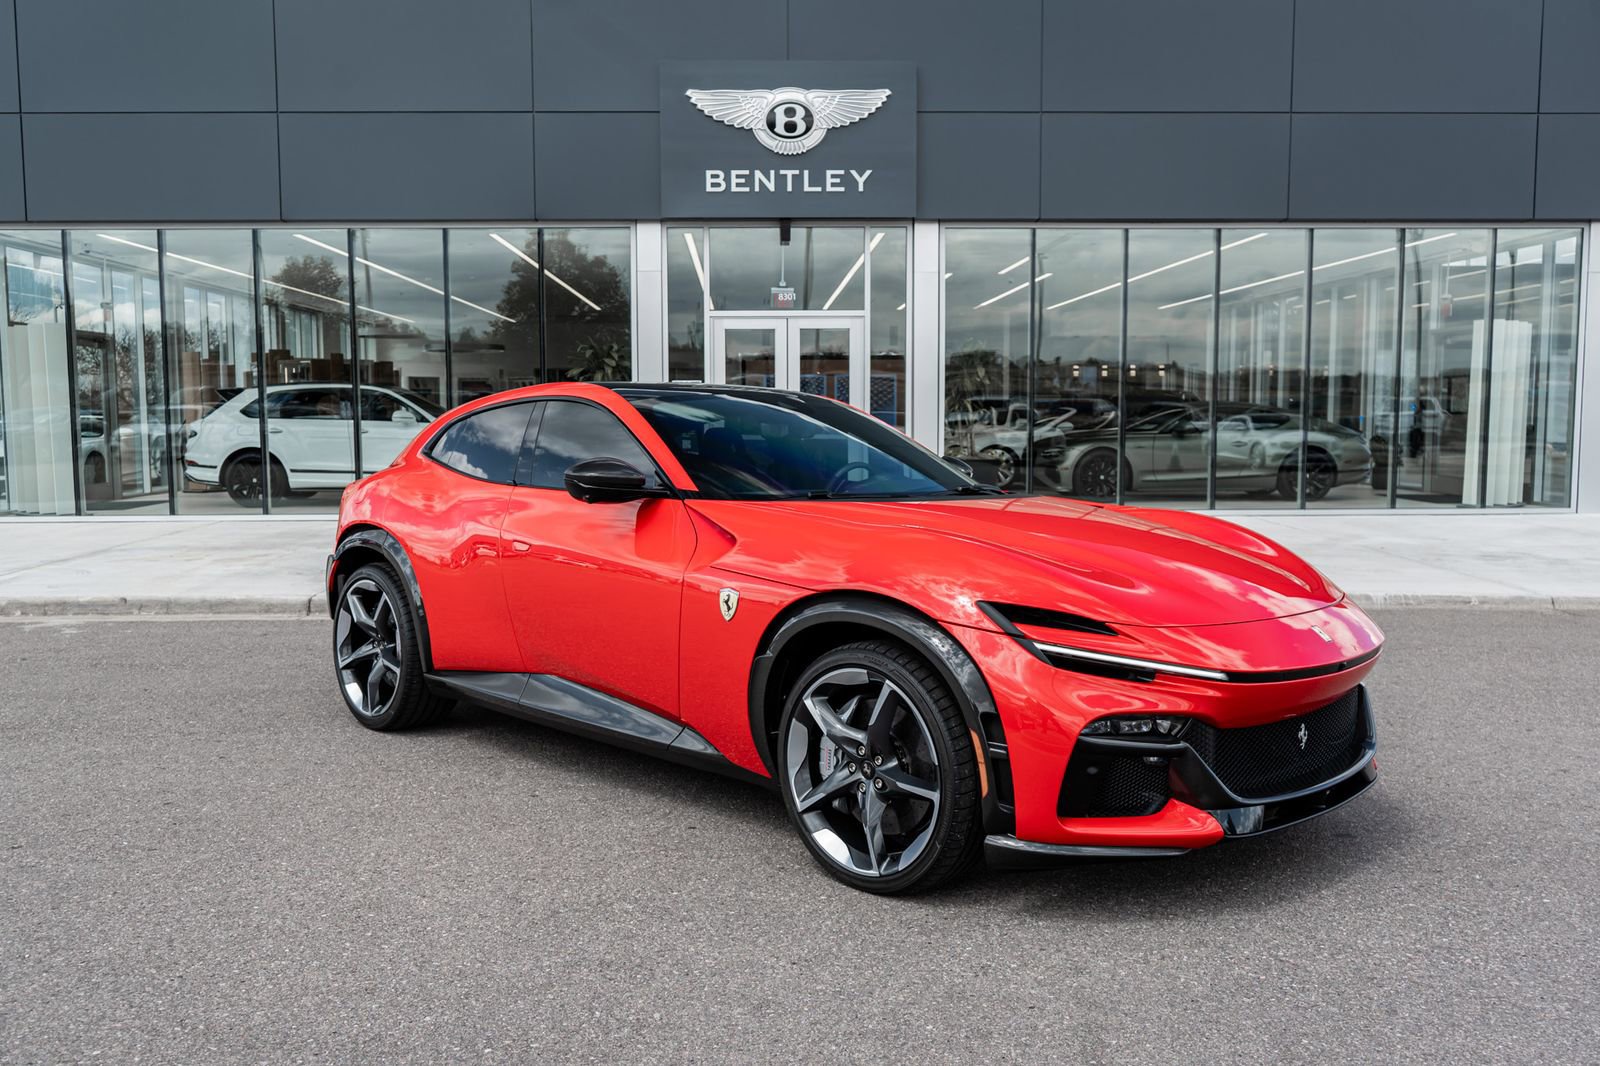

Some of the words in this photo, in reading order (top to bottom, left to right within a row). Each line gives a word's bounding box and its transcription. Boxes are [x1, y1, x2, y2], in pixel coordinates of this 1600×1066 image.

[773, 103, 807, 137] B
[705, 169, 873, 193] BENTLEY
[778, 292, 797, 301] 8301
